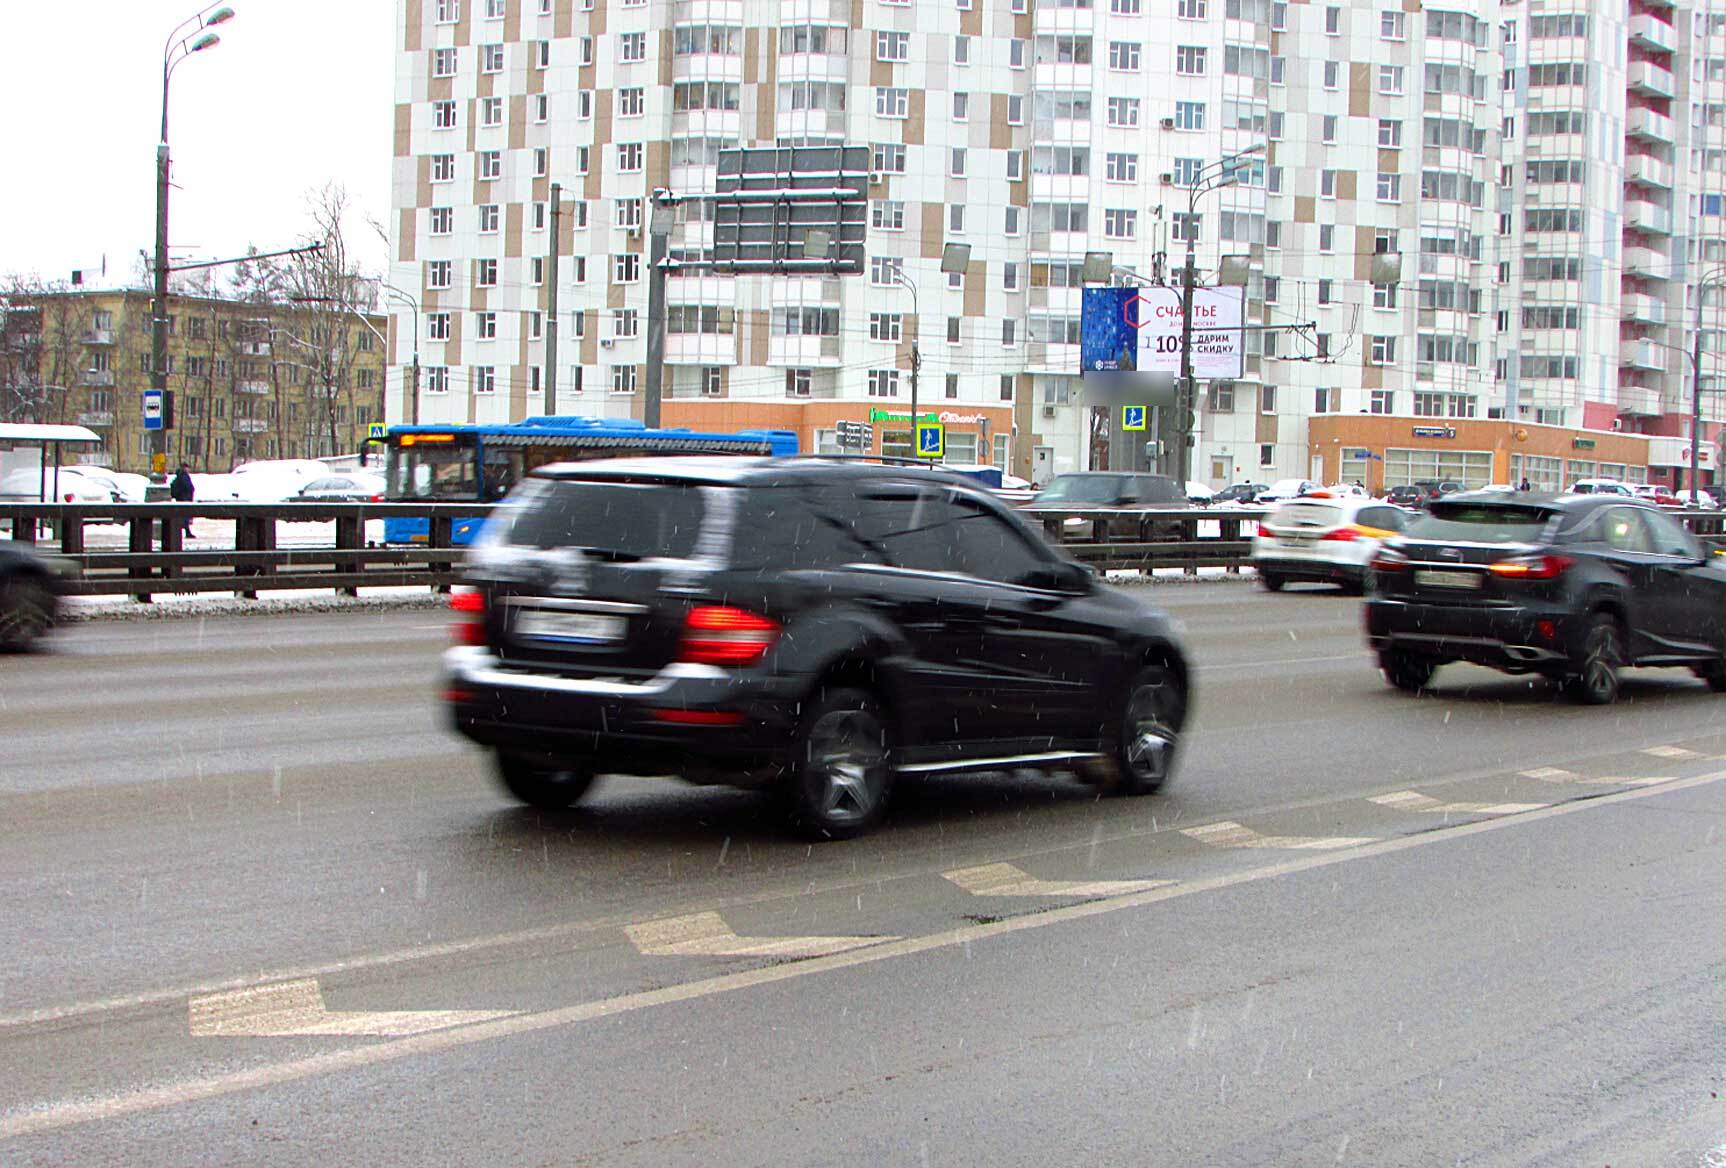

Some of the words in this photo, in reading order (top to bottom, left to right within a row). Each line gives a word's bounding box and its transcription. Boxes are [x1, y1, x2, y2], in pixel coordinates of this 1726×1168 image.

[1156, 305, 1217, 318] СЧАТЬЕ
[1197, 335, 1229, 344] ДАРИМ
[1197, 345, 1234, 354] СКИДКУ
